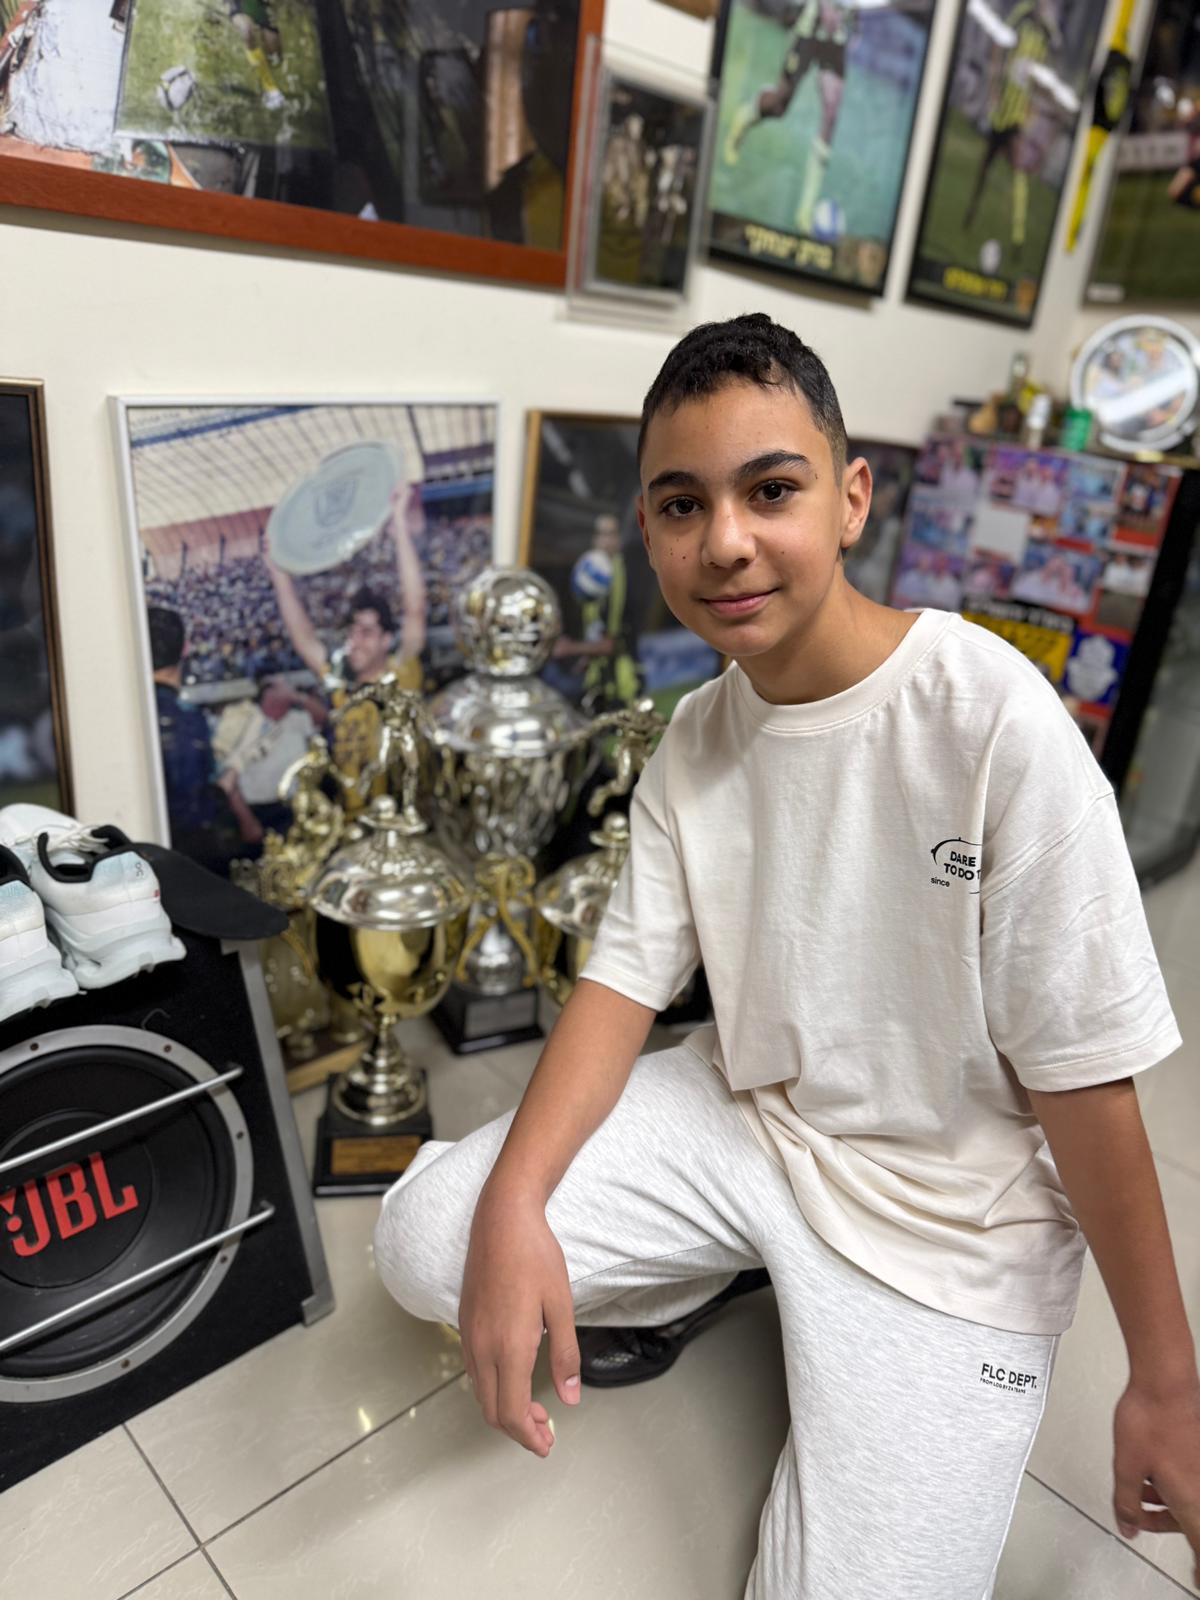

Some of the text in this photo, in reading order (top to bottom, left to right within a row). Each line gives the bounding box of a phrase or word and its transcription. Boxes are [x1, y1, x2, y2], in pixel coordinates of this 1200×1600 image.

[950, 851, 976, 867] DARE
[943, 863, 957, 875] TO
[958, 867, 975, 880] DO
[930, 876, 950, 887] since
[12, 1151, 139, 1257] JBL
[981, 1363, 1037, 1389] FLC DEPT.
